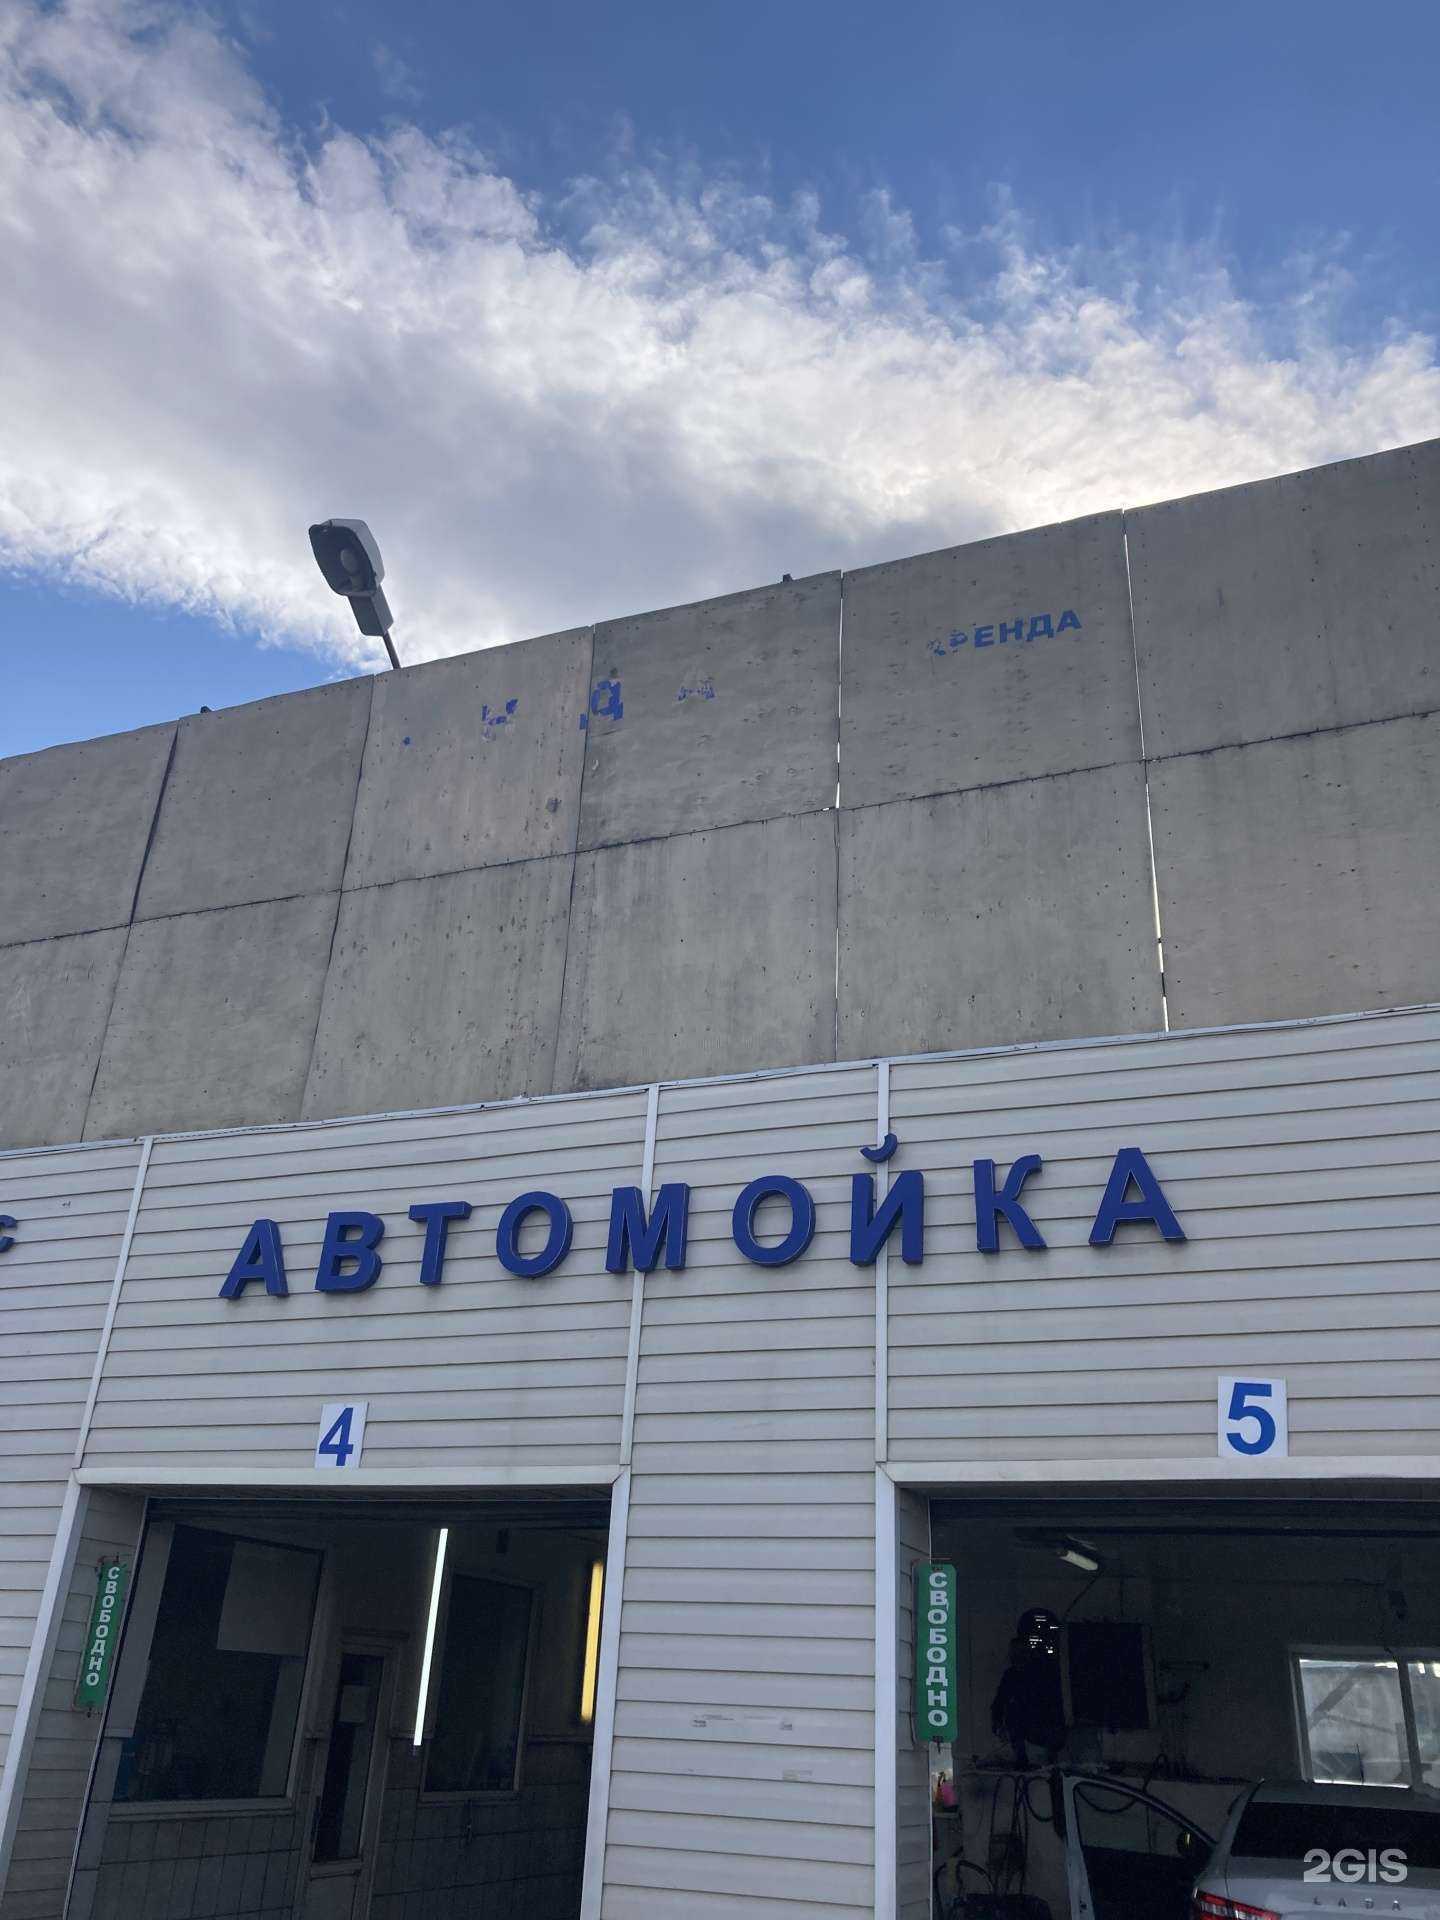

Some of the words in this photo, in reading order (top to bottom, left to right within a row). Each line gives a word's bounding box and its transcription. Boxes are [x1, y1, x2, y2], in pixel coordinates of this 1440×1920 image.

[219, 1133, 1187, 1299] АВТОМОЙКА
[318, 1407, 354, 1466] 4
[1226, 1382, 1277, 1456] 5
[85, 1566, 121, 1686] СВОБОДНО
[926, 1572, 949, 1727] СВОБОДНО
